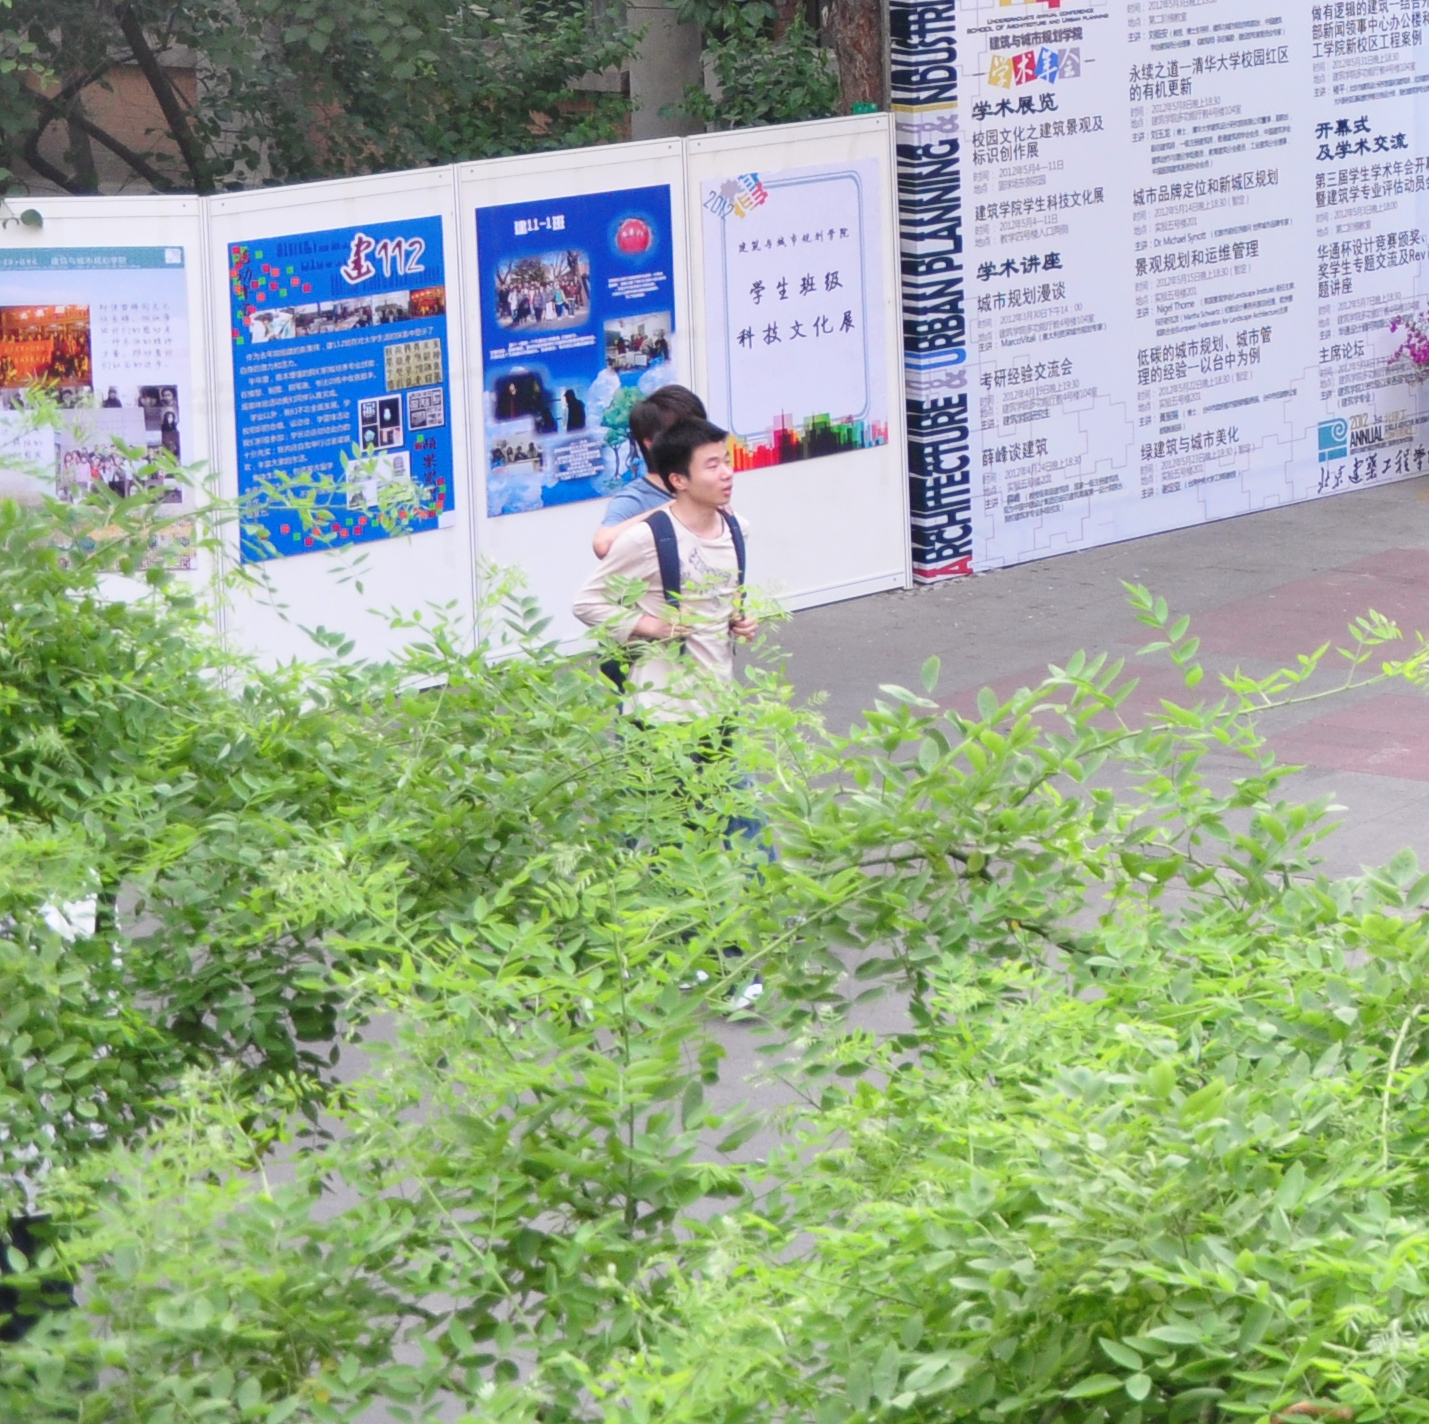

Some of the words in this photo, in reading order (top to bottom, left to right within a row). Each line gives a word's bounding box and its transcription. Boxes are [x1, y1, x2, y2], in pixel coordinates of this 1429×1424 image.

[989, 26, 1084, 51] 建筑与城市规划学院
[1312, 29, 1423, 59] 工学院新校区工程案例
[1129, 45, 1290, 83] 永续之道—清华大学校园红区
[1129, 76, 1193, 102] 的有机更新
[971, 92, 1059, 121] 学术展览
[972, 115, 1104, 149] 校园文化之建筑景观及
[1314, 114, 1372, 140] 开幕式
[972, 141, 1039, 167] 标识创作展
[1315, 131, 1410, 162] 及学术交流
[1132, 168, 1279, 207] 城市品牌定位和新城区规划
[703, 190, 736, 222] 2012
[896, 137, 964, 277] PLANNING
[974, 186, 1105, 222] 建筑学院学生科技文化展
[738, 227, 851, 254] 建筑与城市规划学院
[340, 232, 426, 285] 建112
[976, 251, 1063, 282] 学术讲座
[1135, 239, 1260, 277] 景观规划和运维管理
[749, 270, 844, 306] 学生班级
[977, 280, 1066, 313] 城市规划漫谈
[1318, 276, 1354, 299] 题讲座
[736, 309, 856, 350] 科技文化展
[1137, 325, 1273, 367] 低碳的城市规划、城市管
[1319, 339, 1365, 365] 主席论坛
[980, 357, 1074, 391] 考研经验交流会
[1137, 346, 1261, 386] 理的经验—以台中为例
[981, 437, 1048, 467] 薛峰谈建筑
[1140, 426, 1240, 461] 绿建筑与城市美化
[1349, 424, 1385, 449] ANNUAL
